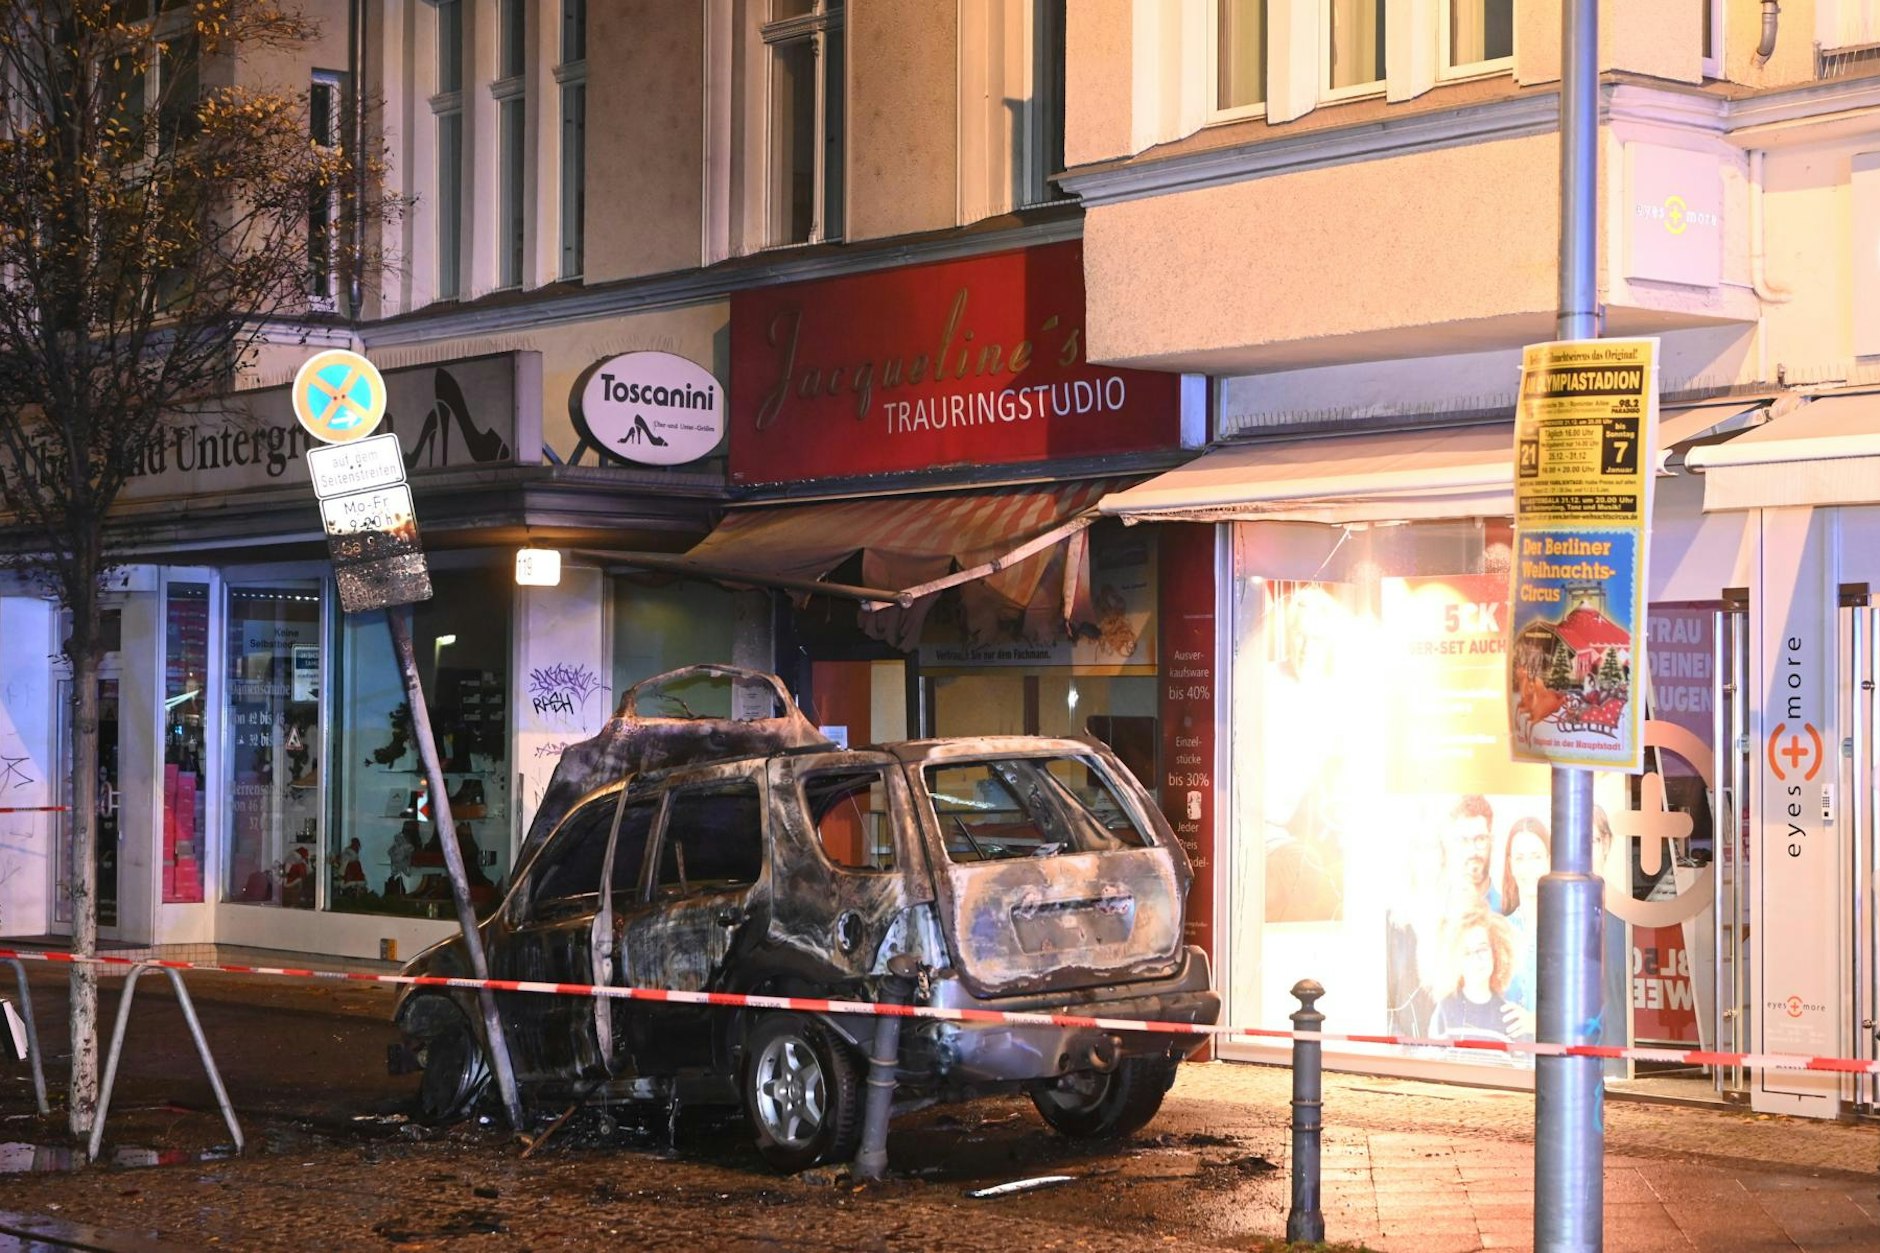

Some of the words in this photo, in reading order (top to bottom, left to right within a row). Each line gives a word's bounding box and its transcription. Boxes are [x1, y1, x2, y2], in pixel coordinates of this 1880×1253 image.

[601, 373, 714, 410] Toscanini
[884, 376, 1126, 434] TRAURINGSTUDIO
[1521, 443, 1536, 466] 21
[1613, 440, 1629, 463] 7
[1523, 537, 1543, 556] Der
[1545, 537, 1612, 556] Berliner
[1522, 560, 1616, 580] Weihnachts-
[1520, 583, 1561, 602] Circus
[1647, 615, 1702, 645] TRAU
[1174, 650, 1205, 661] Ausver-
[1169, 667, 1210, 678] kaufsware
[1787, 636, 1802, 719] more
[1169, 686, 1184, 700] bis
[1187, 685, 1210, 700] 40%
[1175, 735, 1203, 747] Einzel-
[1175, 753, 1202, 765] stücke
[1168, 772, 1184, 787] bis
[1186, 771, 1210, 787] 30%
[1177, 821, 1200, 833] Jeder
[1787, 785, 1806, 858] eyes
[1767, 1001, 1787, 1010] eyes
[1802, 1003, 1826, 1012] more
